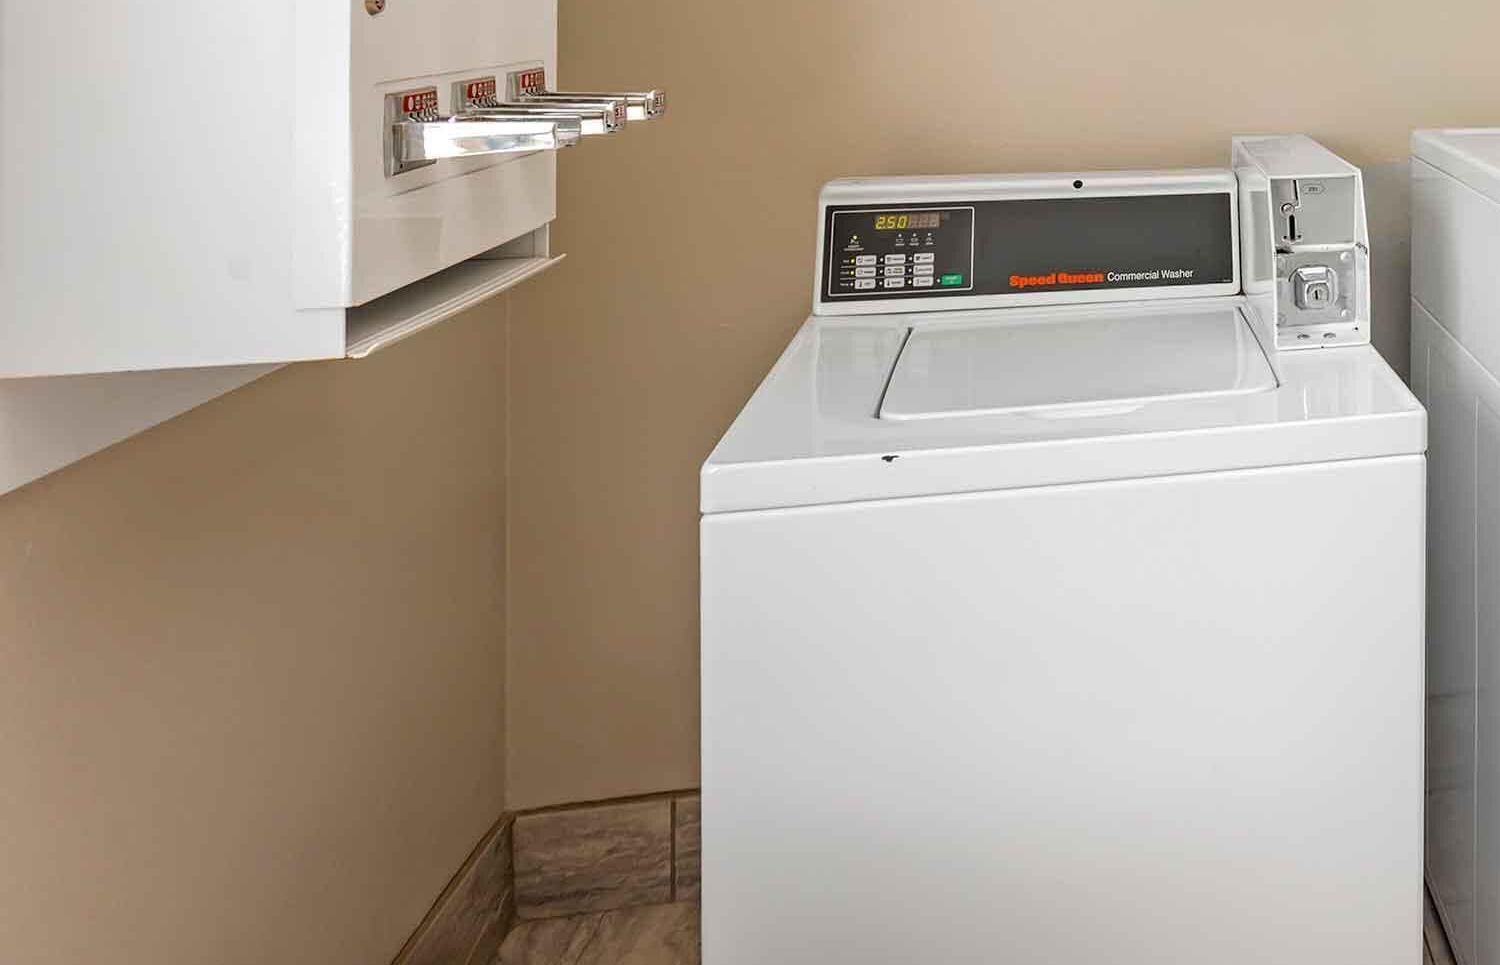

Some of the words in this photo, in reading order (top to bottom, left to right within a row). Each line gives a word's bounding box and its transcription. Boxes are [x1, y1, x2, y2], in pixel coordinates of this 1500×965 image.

[1009, 272, 1057, 288] Speed
[1057, 271, 1105, 285] Queen
[1106, 269, 1160, 283] Commercial
[1160, 268, 1195, 280] Washer
